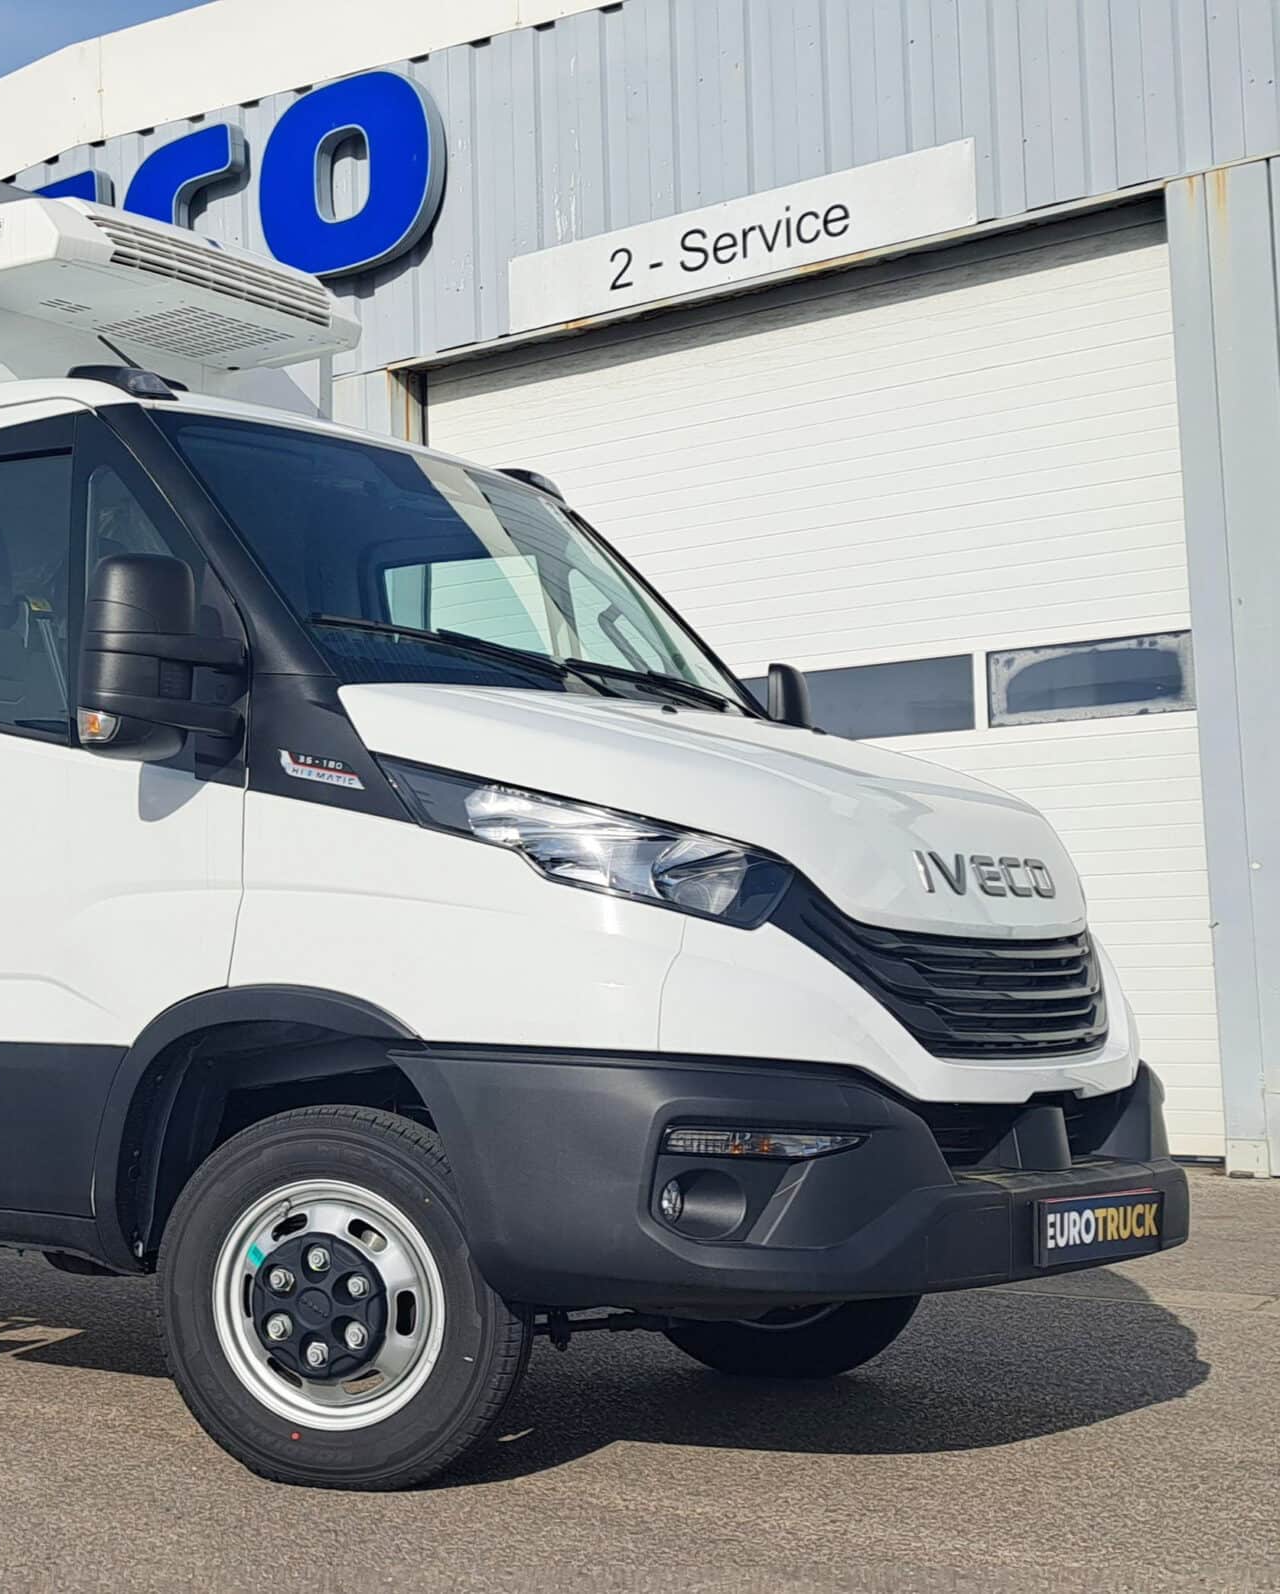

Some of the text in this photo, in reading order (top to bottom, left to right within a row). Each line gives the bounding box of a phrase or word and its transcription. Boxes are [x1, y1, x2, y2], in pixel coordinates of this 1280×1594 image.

[610, 247, 634, 291] 2
[679, 203, 850, 272] Service
[912, 850, 1056, 899] IVECO
[1046, 1203, 1159, 1249] EUROTRUCK
